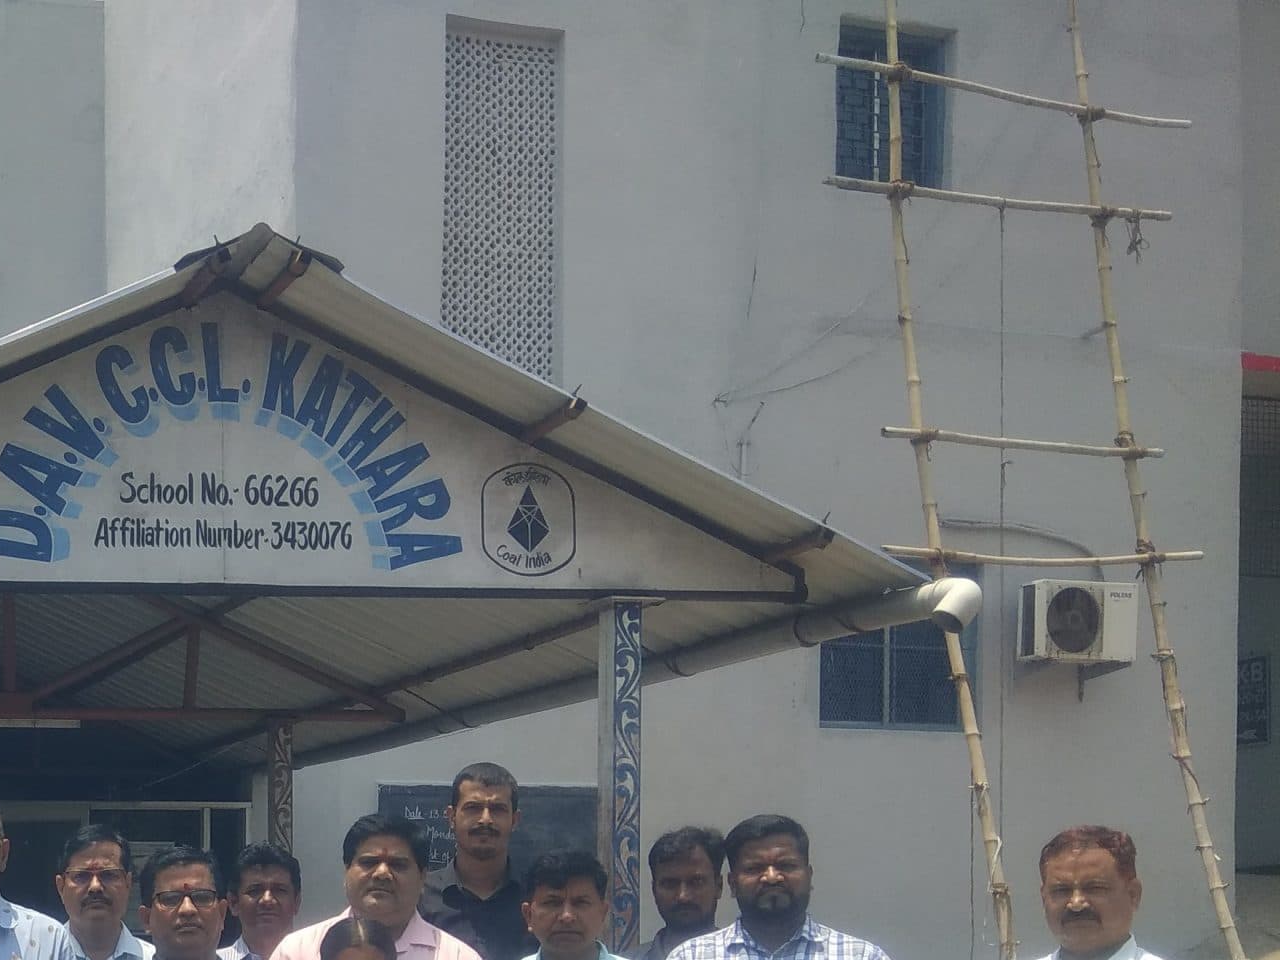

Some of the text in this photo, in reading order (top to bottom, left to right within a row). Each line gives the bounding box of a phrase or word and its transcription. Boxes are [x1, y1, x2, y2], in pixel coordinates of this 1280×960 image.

[261, 330, 464, 572] KATHARA
[119, 471, 194, 505] School
[243, 473, 320, 507] 66266
[93, 516, 192, 549] Affiliation
[496, 544, 552, 569] Coal India
